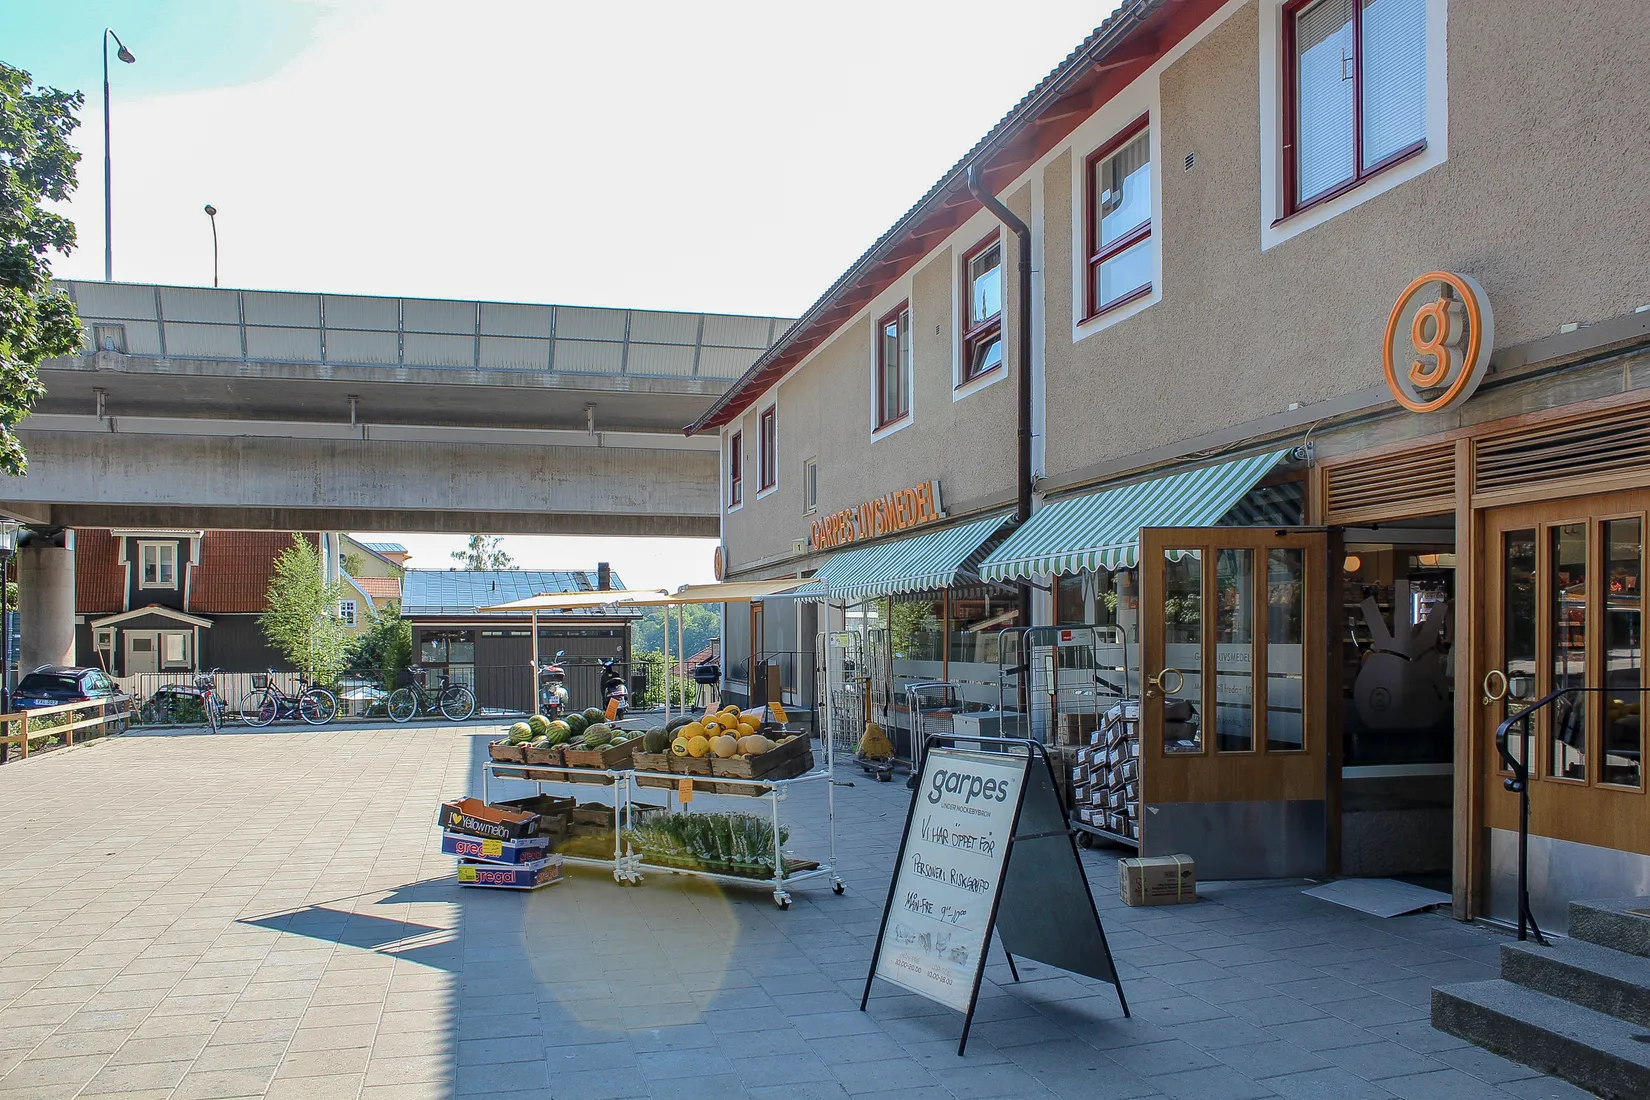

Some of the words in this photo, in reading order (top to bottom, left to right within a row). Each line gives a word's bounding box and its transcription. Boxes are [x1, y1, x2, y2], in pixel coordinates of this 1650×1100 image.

[811, 508, 855, 550] GARPES
[856, 480, 943, 538] LIVSMEDEL
[927, 769, 1009, 804] garpes
[941, 802, 957, 811] UNDER
[932, 826, 948, 844] HAR
[455, 841, 500, 859] greg
